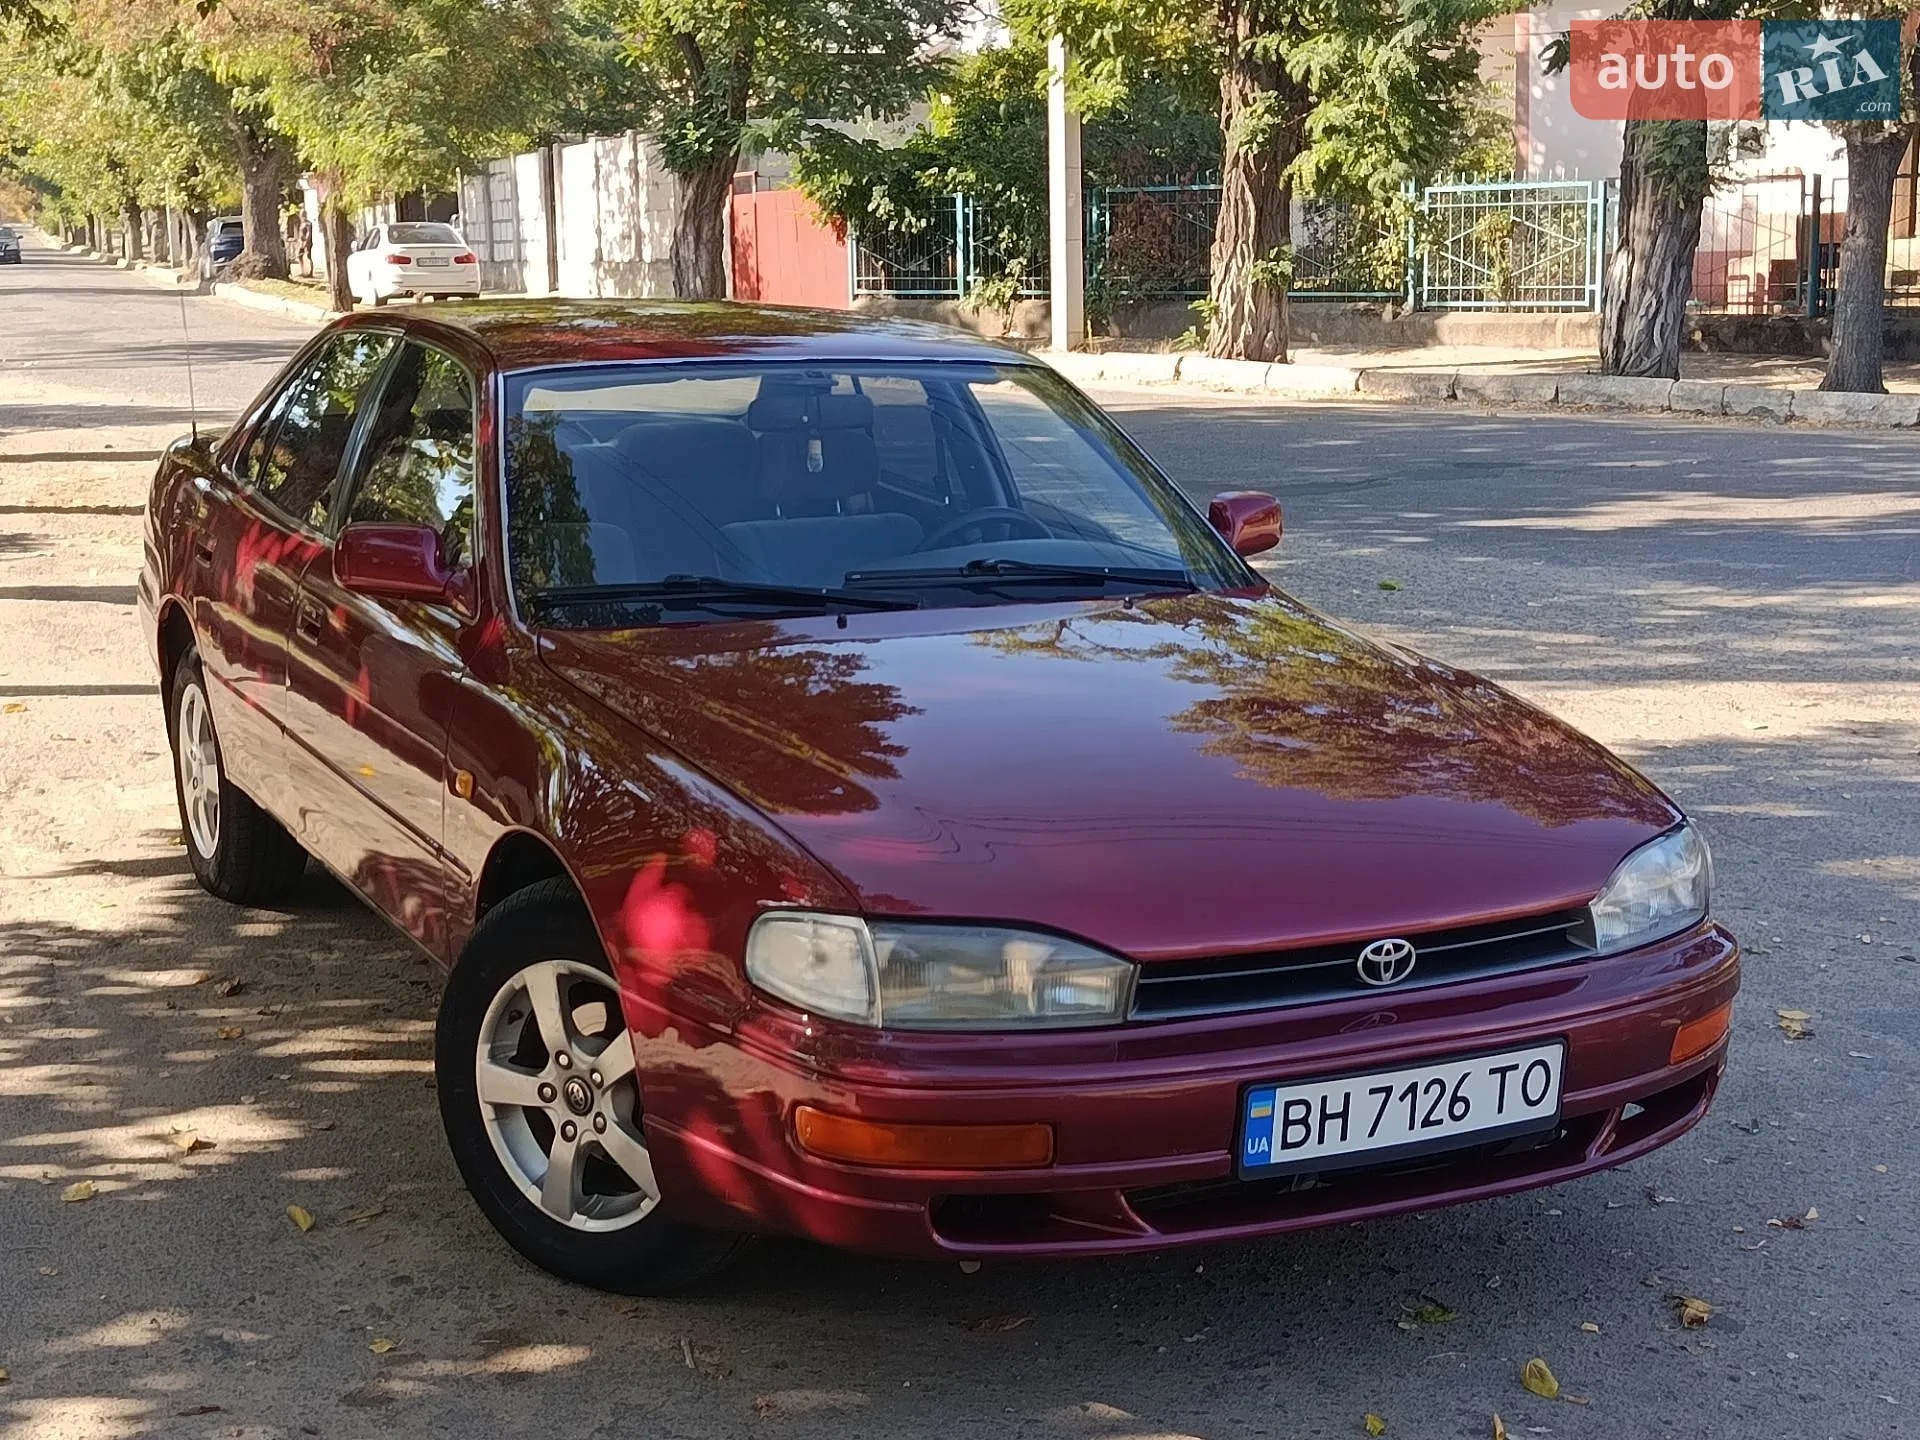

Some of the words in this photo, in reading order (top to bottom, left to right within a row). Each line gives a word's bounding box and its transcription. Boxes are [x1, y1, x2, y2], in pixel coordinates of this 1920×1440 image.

[1280, 1091, 1351, 1151] BH
[1368, 1071, 1472, 1138] 7126
[1489, 1058, 1551, 1115] TO
[1247, 1138, 1269, 1155] UA
